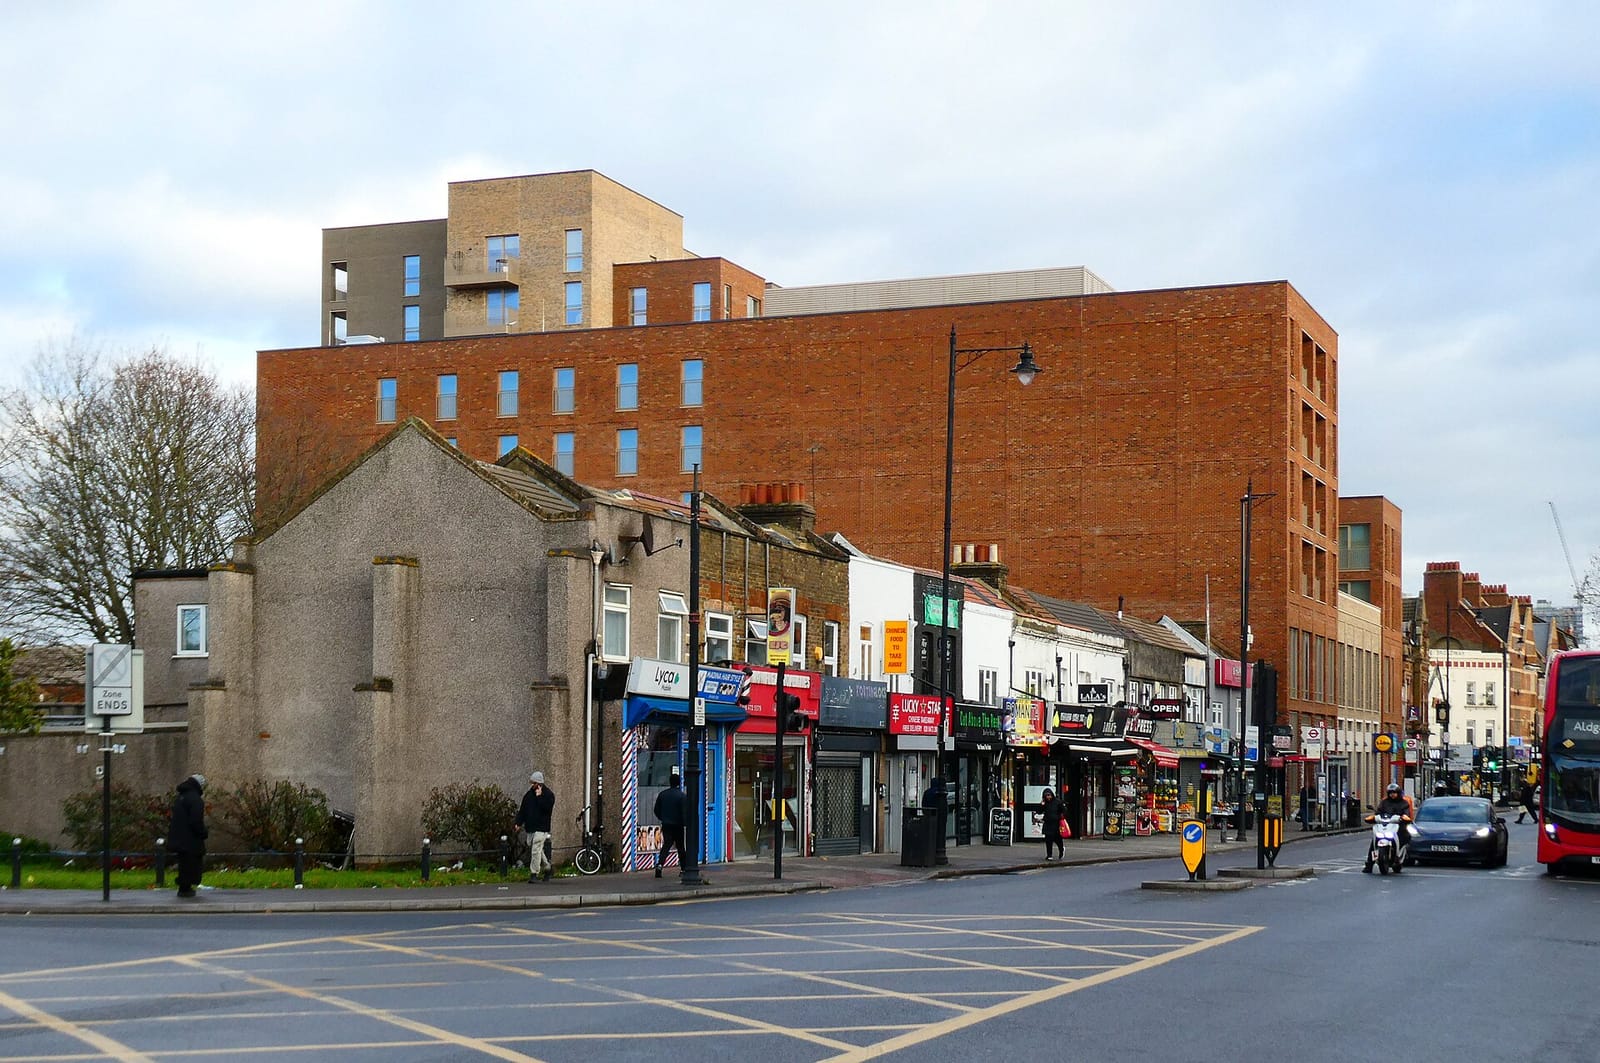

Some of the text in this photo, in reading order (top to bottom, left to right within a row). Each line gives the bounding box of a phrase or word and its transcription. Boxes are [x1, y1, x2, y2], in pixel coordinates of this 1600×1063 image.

[655, 666, 675, 685] Lyca
[103, 690, 122, 698] Zone
[97, 700, 128, 710] ENDS
[901, 698, 920, 713] LUCKY
[1152, 704, 1180, 713] OPEN
[1573, 721, 1600, 735] Aldg
